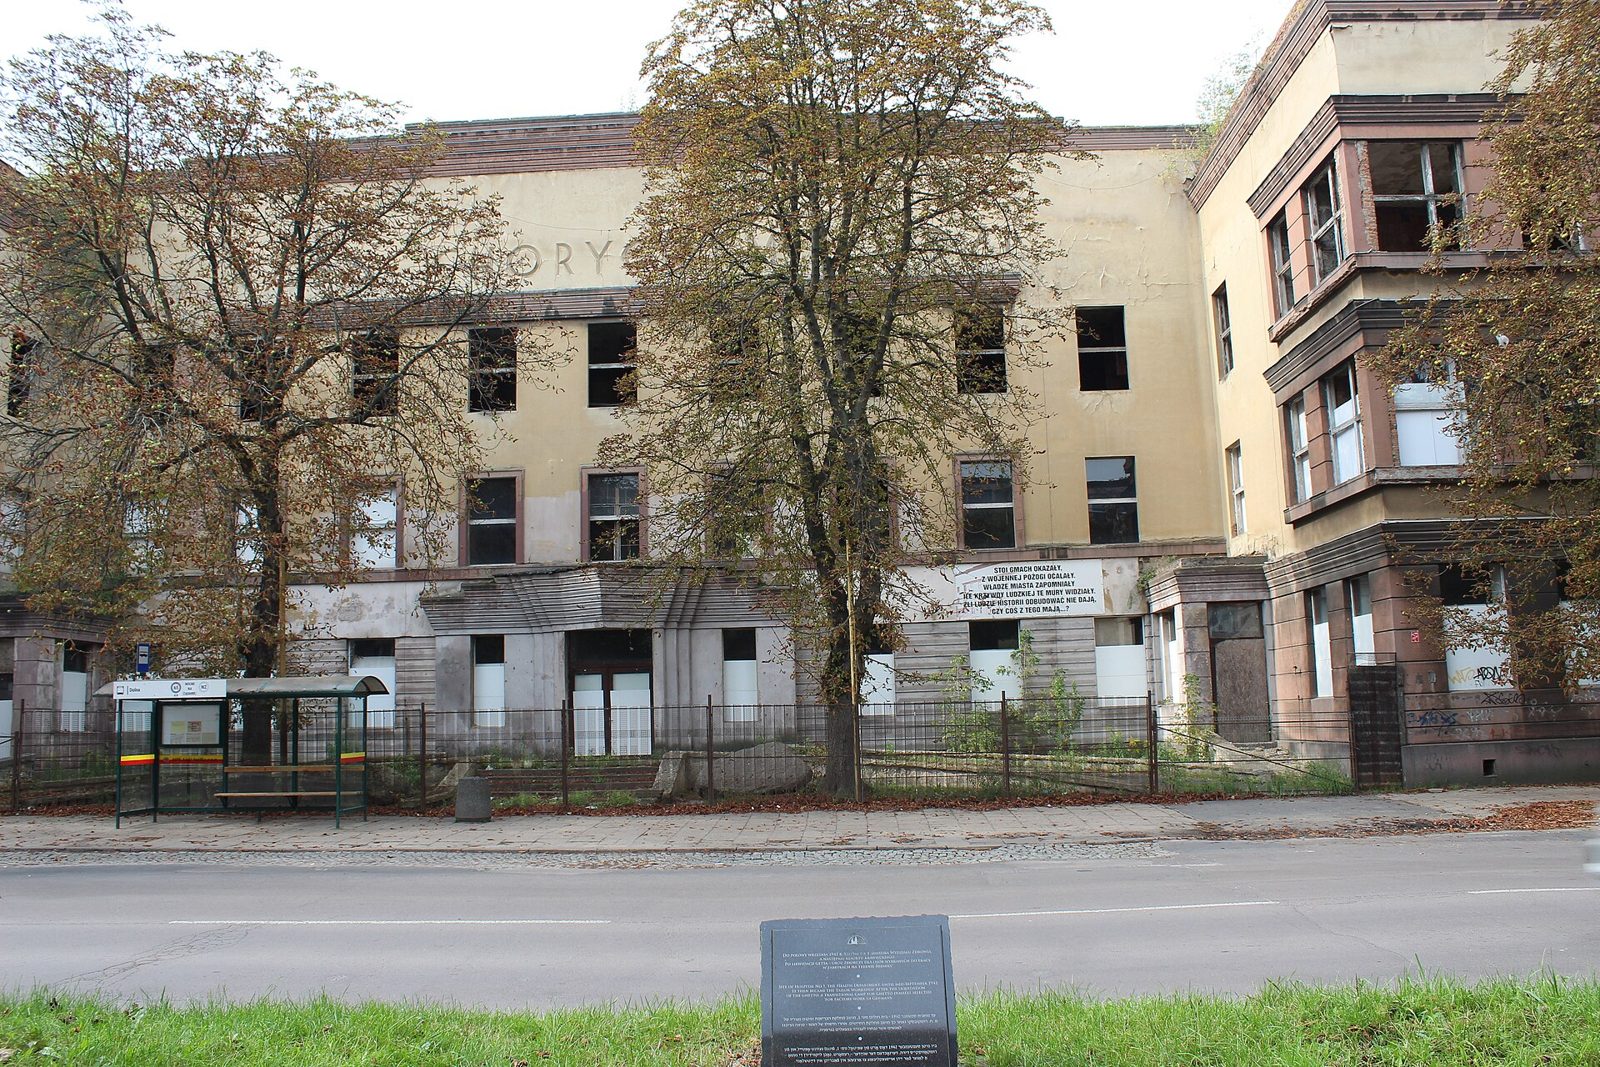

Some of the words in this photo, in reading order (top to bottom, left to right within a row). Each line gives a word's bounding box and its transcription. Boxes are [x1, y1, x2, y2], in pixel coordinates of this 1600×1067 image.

[508, 240, 640, 277] ORY
[1006, 590, 1035, 598] LUDZKIEJ
[1025, 597, 1065, 605] ODBUDOWAĆ
